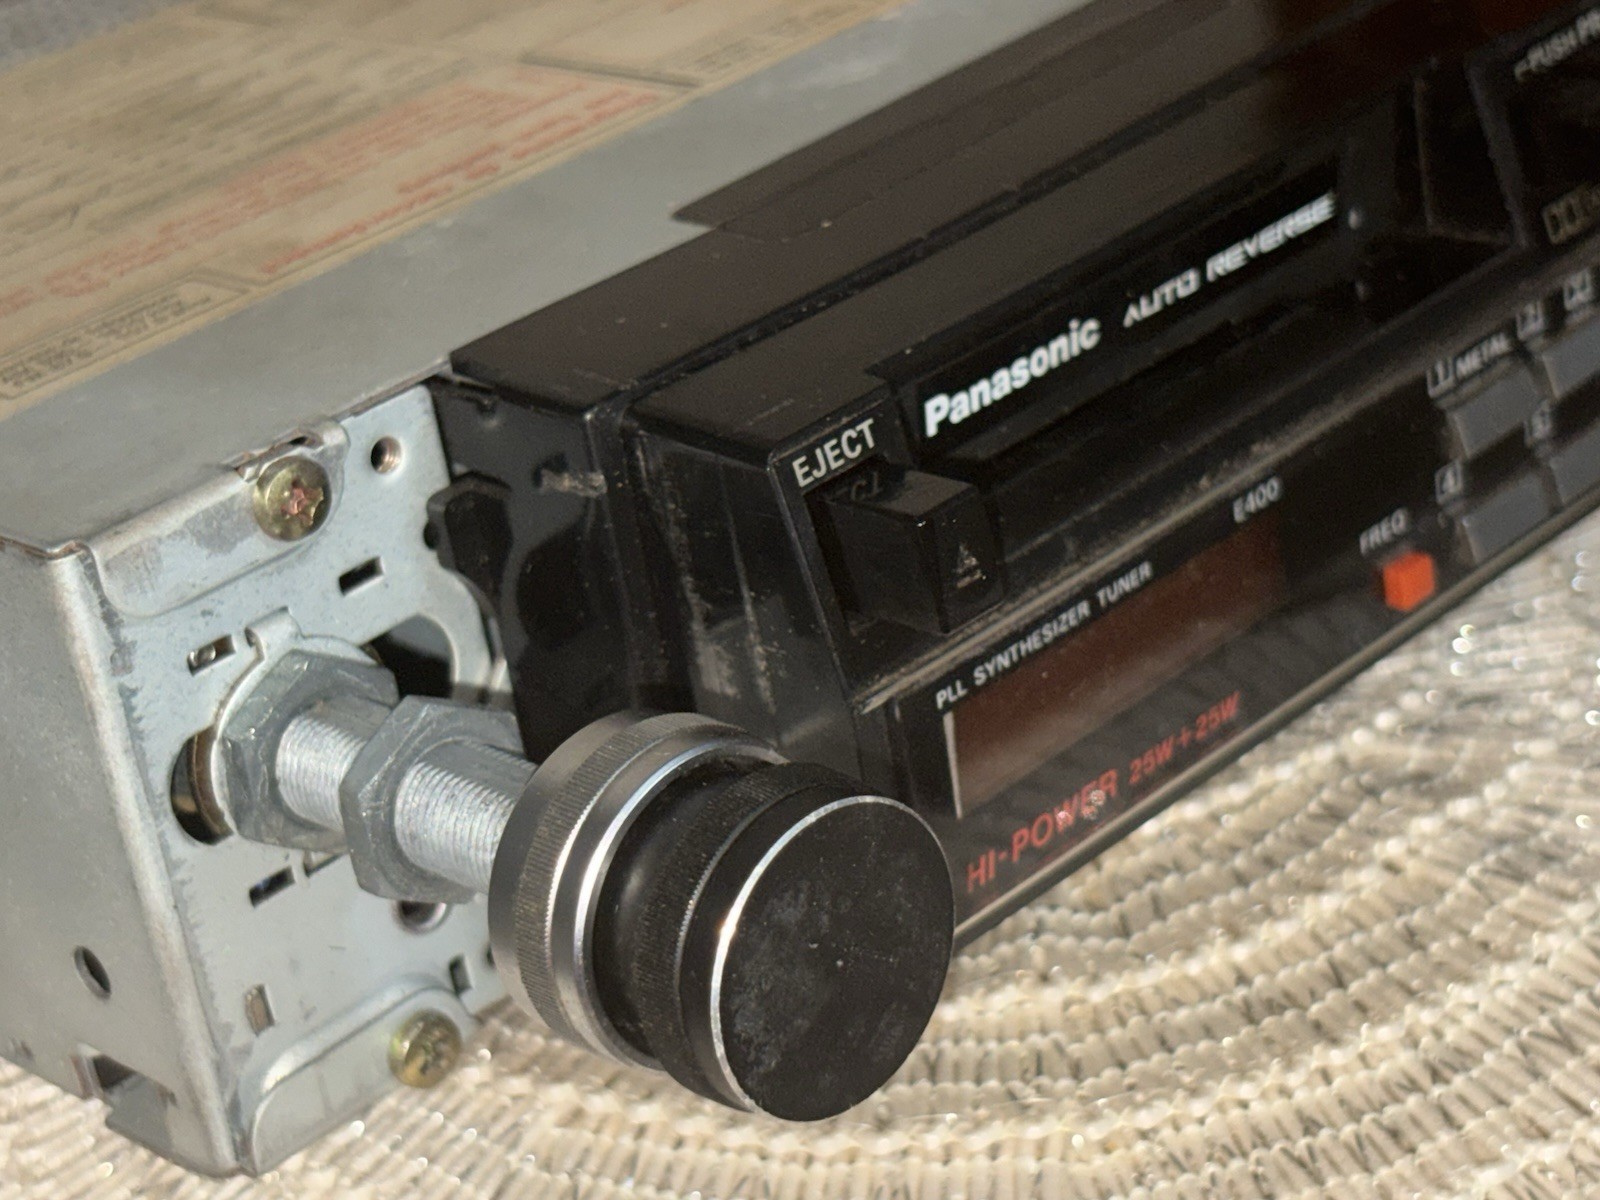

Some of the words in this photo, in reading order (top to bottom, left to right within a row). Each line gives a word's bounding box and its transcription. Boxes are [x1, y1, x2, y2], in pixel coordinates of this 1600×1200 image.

[924, 318, 1101, 438] Panasonic
[1123, 267, 1200, 328] AUTO
[1206, 192, 1336, 282] REVERSE
[792, 418, 875, 488] EJECT
[1232, 476, 1281, 523] E400
[936, 680, 967, 709] PLL
[973, 600, 1091, 686] SYNTHESIZER
[1096, 560, 1153, 607] TUNER
[967, 768, 1118, 893] HI-POWER
